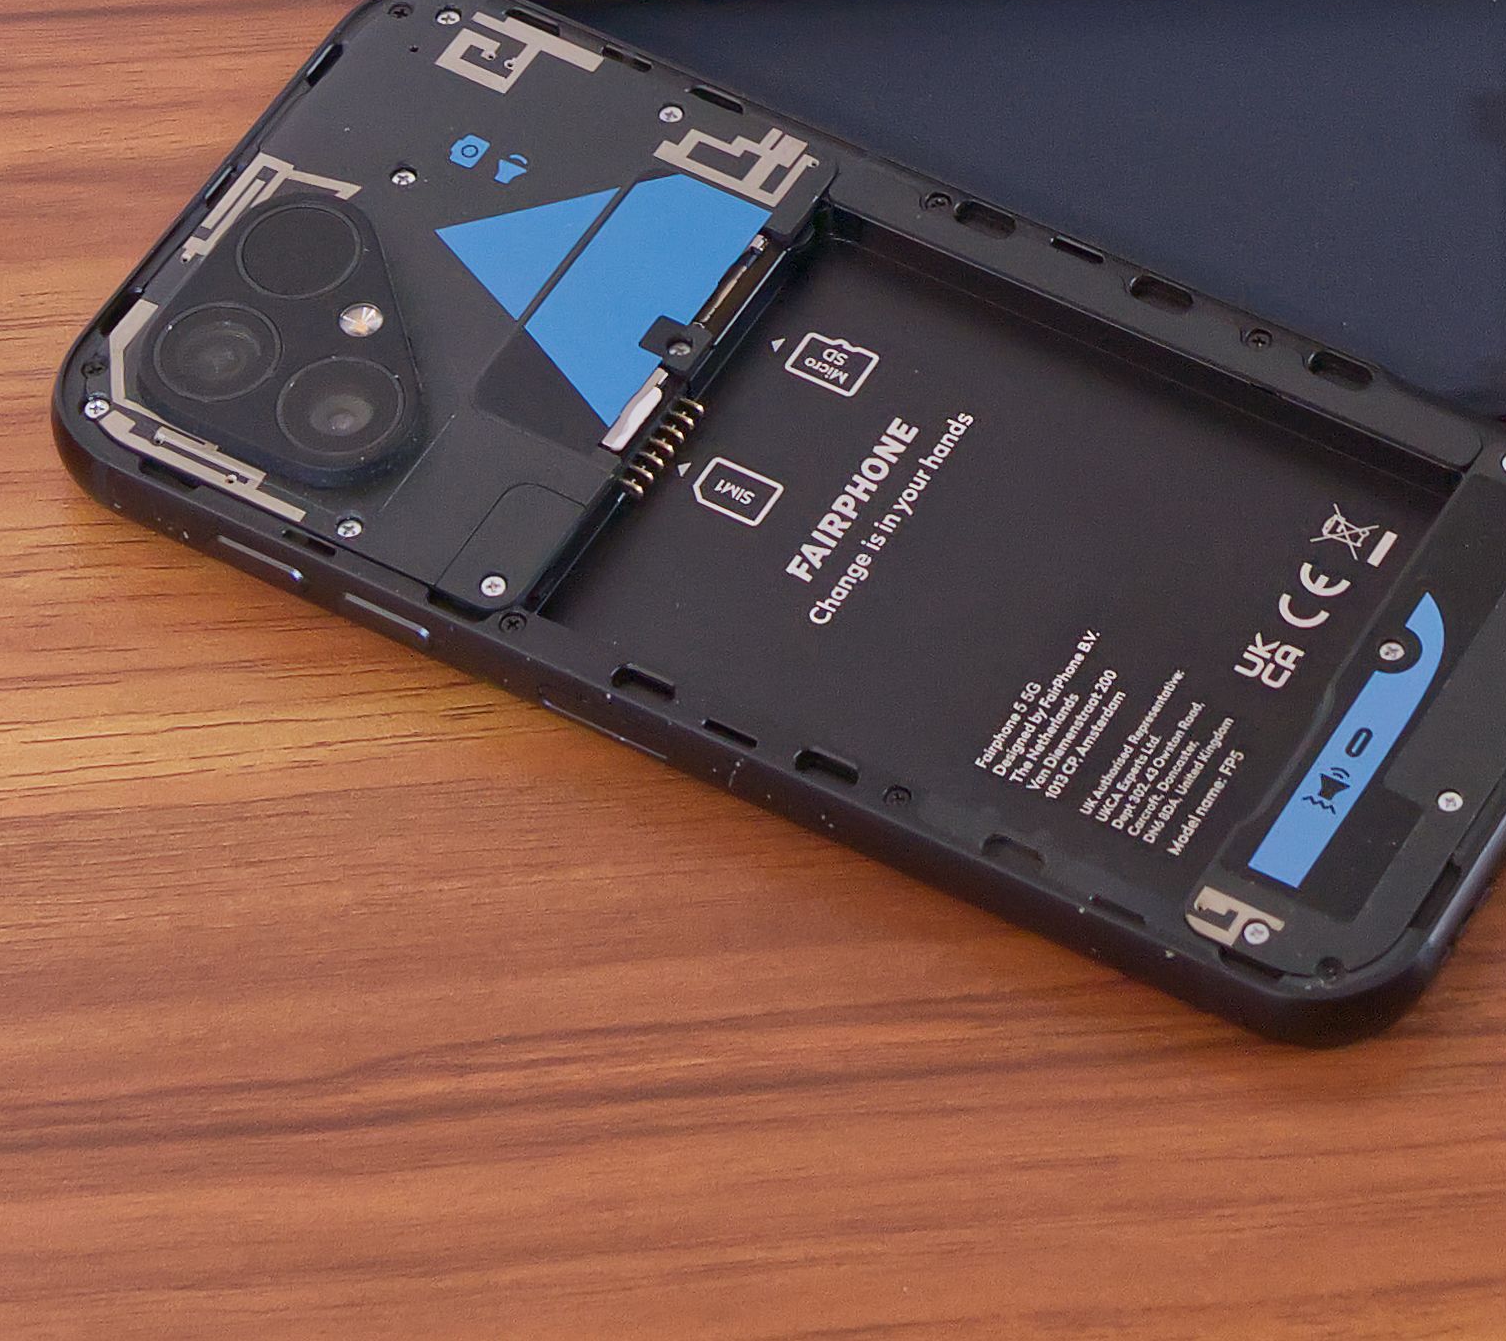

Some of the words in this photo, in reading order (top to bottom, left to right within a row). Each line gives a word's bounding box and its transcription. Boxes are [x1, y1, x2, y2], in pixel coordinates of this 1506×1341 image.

[805, 357, 848, 384] Micro
[822, 348, 848, 365] SD
[714, 479, 755, 505] SIM1
[786, 417, 919, 583] FAIRPHONE
[809, 553, 872, 624] Change
[861, 533, 886, 551] is
[874, 514, 901, 532] in
[893, 469, 931, 516] your
[918, 413, 973, 470] hands
[1278, 562, 1351, 628] CE
[1234, 632, 1281, 678] UK
[1261, 644, 1305, 689] CA
[975, 713, 1021, 768] Fairphone
[1013, 702, 1027, 712] 5
[1021, 682, 1041, 702] 5G
[1009, 761, 1033, 783] The
[1027, 693, 1079, 761] Netherlands
[1167, 815, 1202, 856] Model
[1195, 777, 1227, 816] name:
[1219, 749, 1244, 776] FP5
